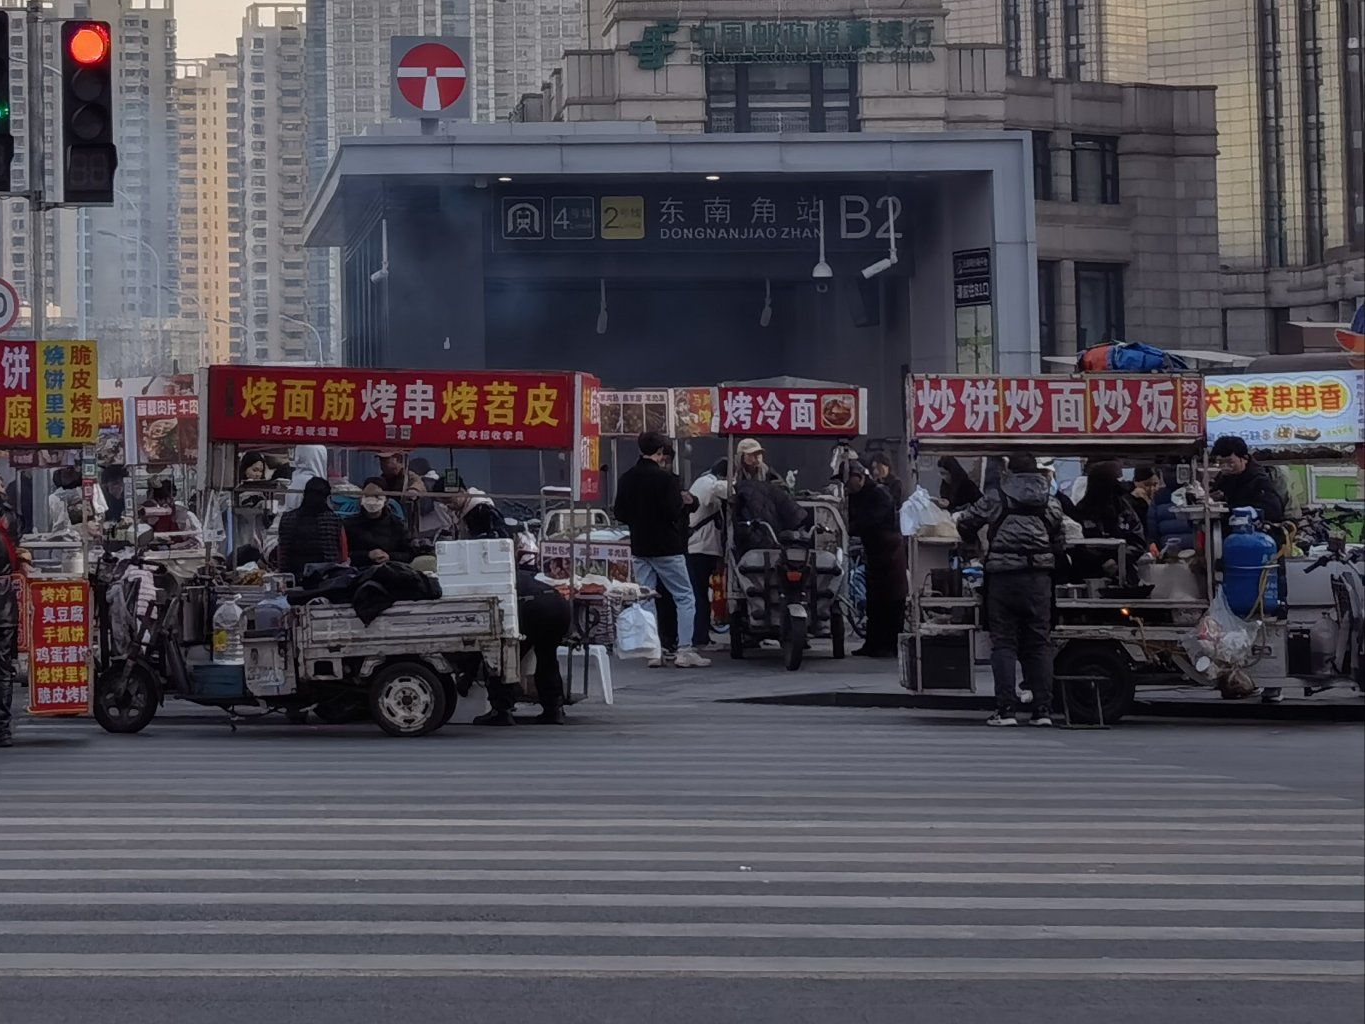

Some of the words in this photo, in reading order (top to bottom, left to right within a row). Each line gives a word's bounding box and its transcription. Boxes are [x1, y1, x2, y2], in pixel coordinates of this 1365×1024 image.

[659, 196, 821, 224] 东南角站
[840, 195, 903, 239] B2
[660, 227, 777, 239] DONGNANJIAO
[43, 345, 65, 439] 烧饼里脊
[70, 345, 92, 438] 脆皮烤肠
[724, 391, 818, 431] 烤冷面
[918, 379, 999, 432] 炒饼
[1005, 379, 1086, 433] 炒面
[1093, 379, 1177, 432] 炒饭
[1204, 384, 1342, 413] 关东煮串串香
[41, 586, 83, 603] 烤冷面
[42, 605, 84, 623] 臭豆腐
[42, 626, 84, 643] 手抓饼
